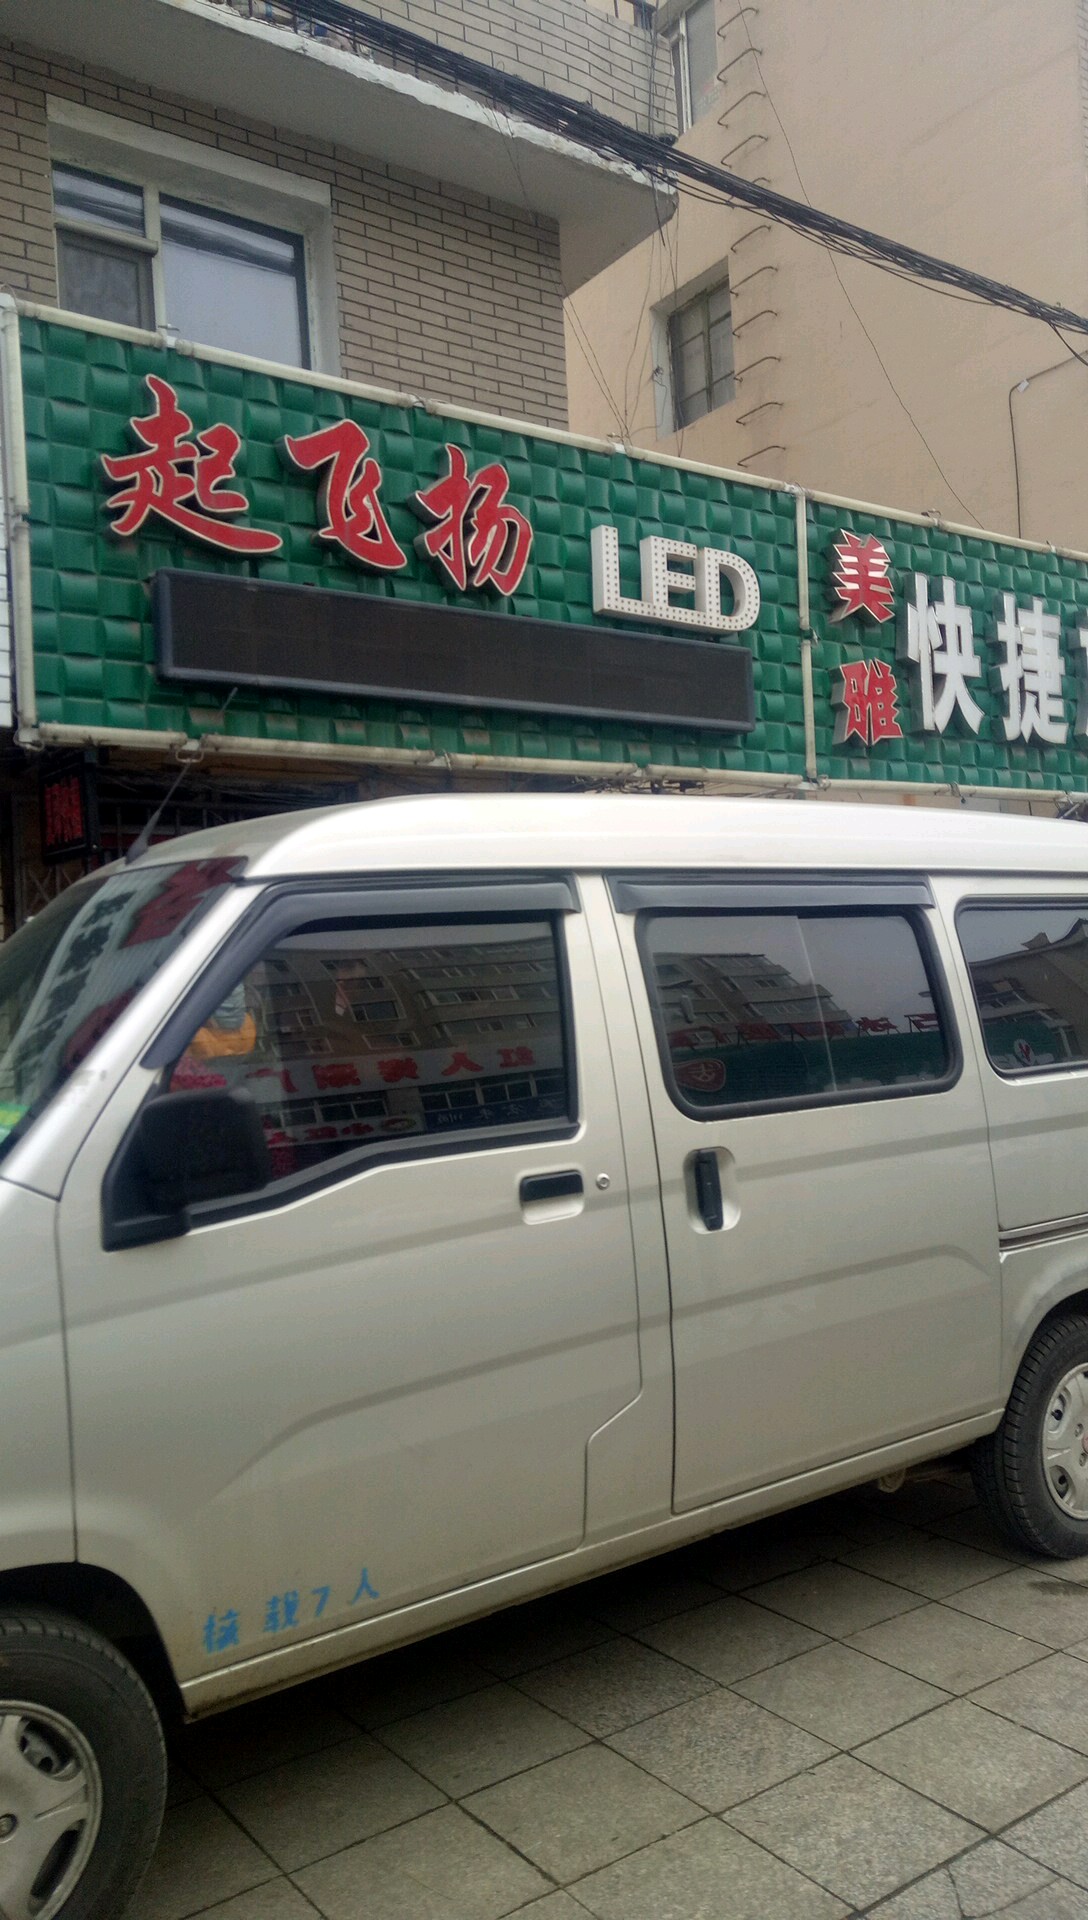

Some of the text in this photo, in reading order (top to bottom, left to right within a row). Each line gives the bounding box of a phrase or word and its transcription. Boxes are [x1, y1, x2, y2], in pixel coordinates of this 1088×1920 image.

[101, 374, 534, 596] 起飞扬
[591, 525, 760, 632] LED
[898, 573, 1088, 745] 快捷
